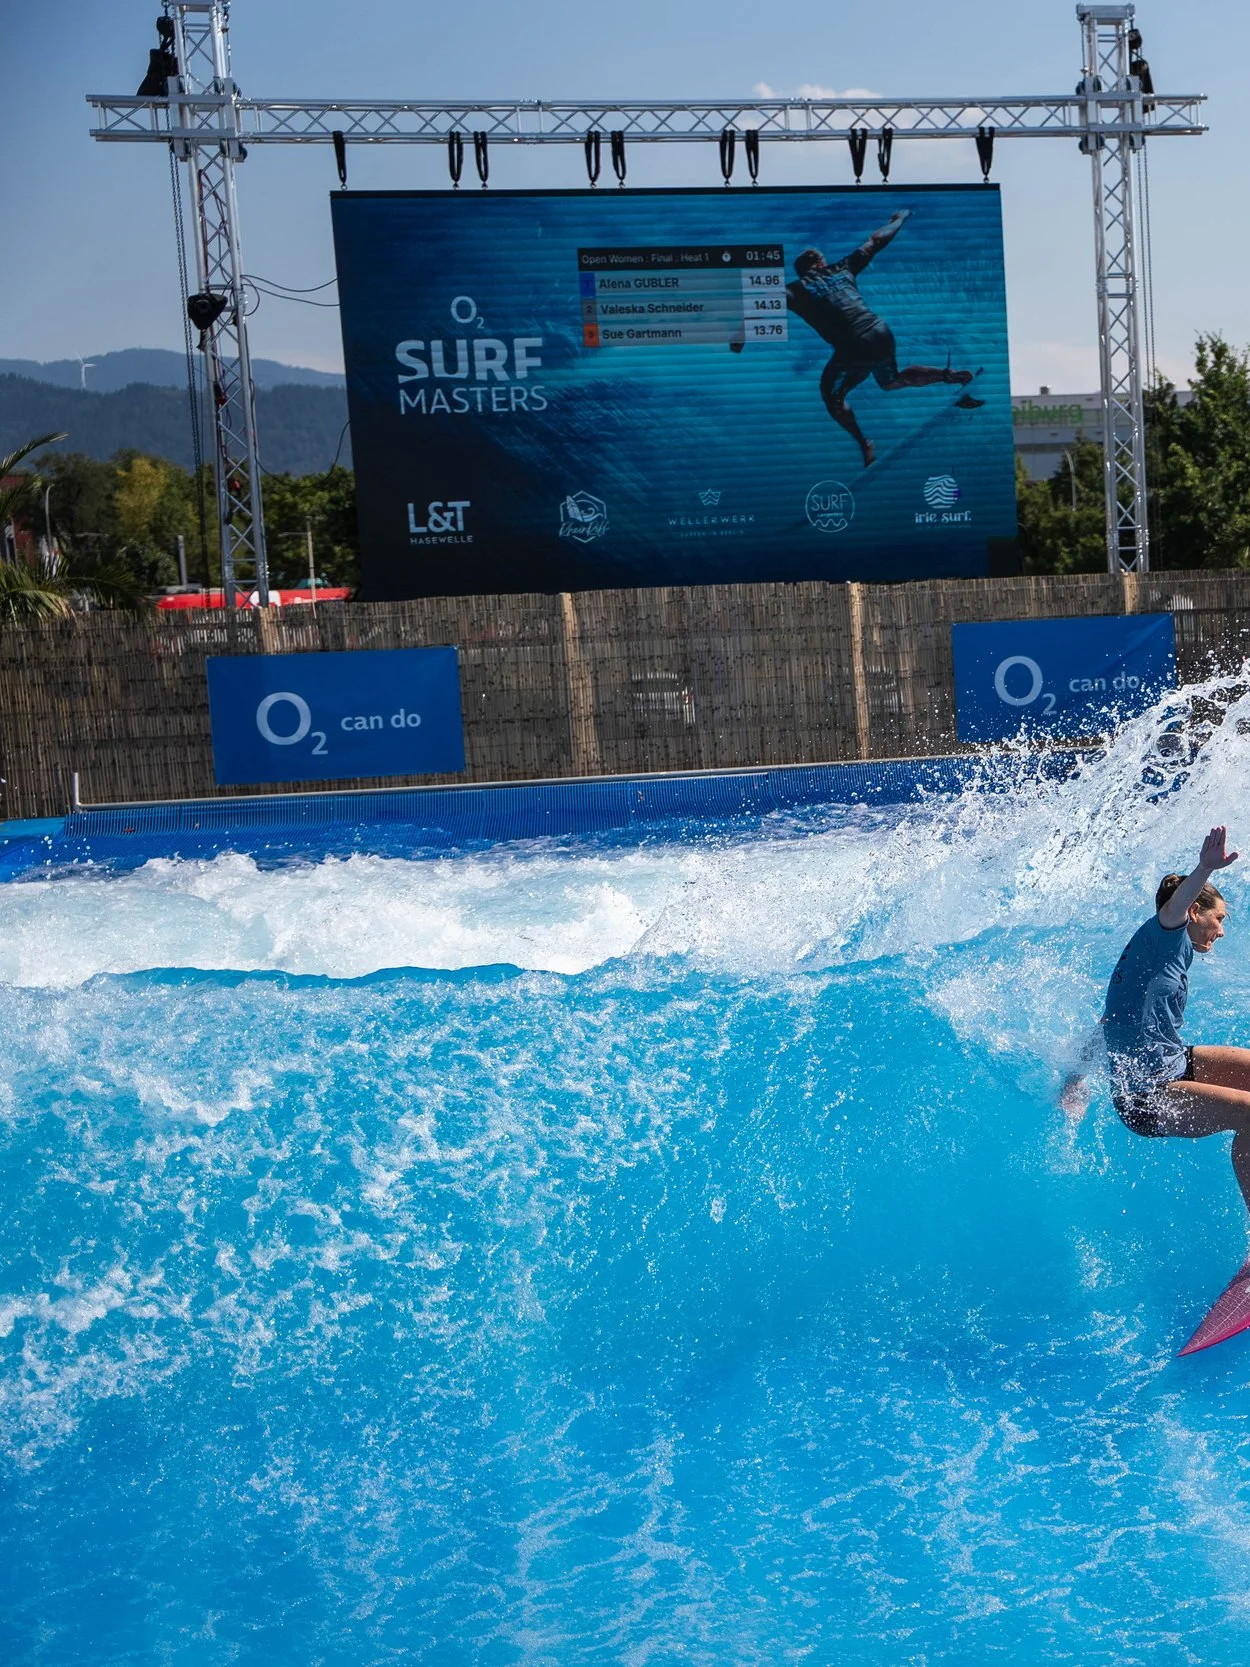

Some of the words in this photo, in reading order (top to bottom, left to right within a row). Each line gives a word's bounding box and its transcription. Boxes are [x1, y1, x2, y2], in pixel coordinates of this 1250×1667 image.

[581, 254, 607, 266] Open
[609, 254, 644, 264] Women
[651, 253, 673, 263] Final
[680, 252, 703, 262] Heat
[746, 250, 780, 261] 01:45
[599, 278, 631, 290] Alena
[634, 277, 679, 289] GUBLER
[749, 275, 780, 286] 14.96
[601, 303, 645, 315] Valeska
[647, 301, 704, 314] Schneider
[754, 300, 781, 310] 14.13
[602, 329, 625, 340] Sue
[626, 328, 682, 339] Gartmann
[753, 325, 783, 336] 13.76
[395, 337, 543, 384] SURF
[399, 385, 548, 415] MASTERS
[810, 493, 849, 512] SURF
[407, 500, 471, 533] L&T
[914, 511, 938, 524] irie
[410, 535, 473, 545] HASEWELLE
[1069, 675, 1107, 693] can
[1112, 670, 1140, 690] do
[340, 714, 383, 731] can
[390, 708, 421, 729] do
